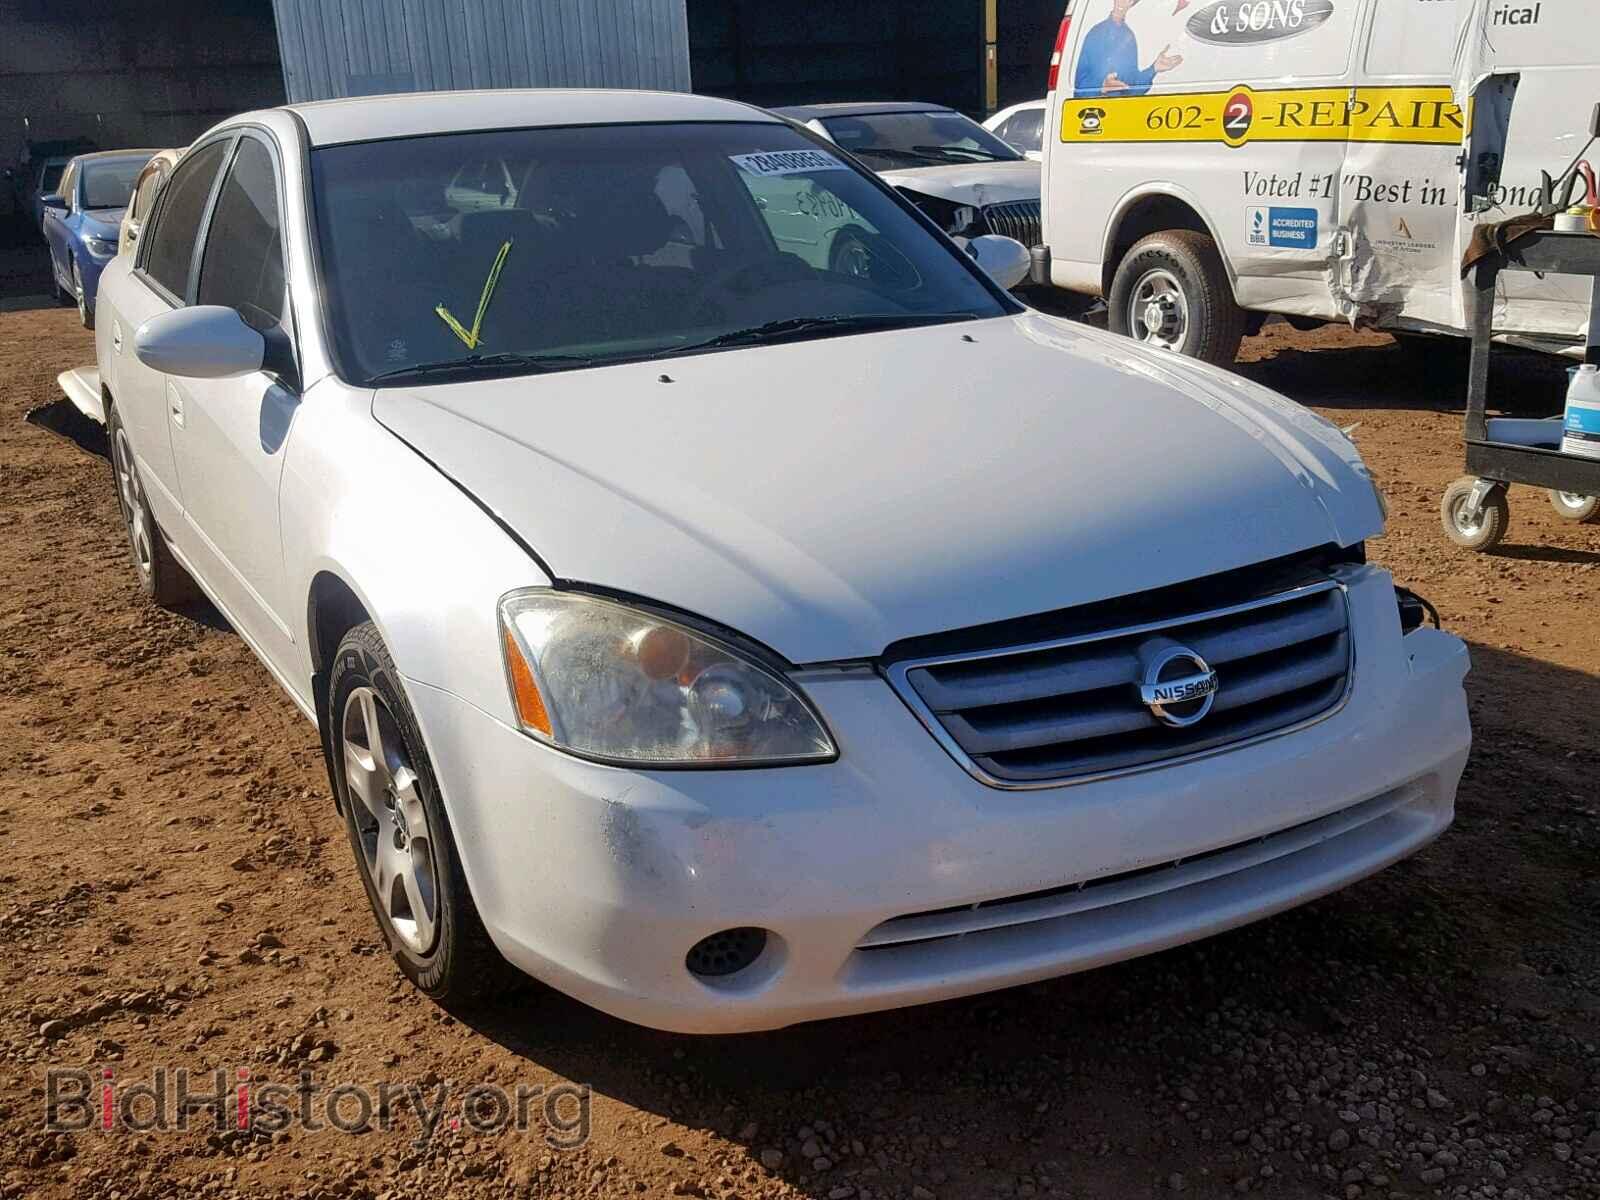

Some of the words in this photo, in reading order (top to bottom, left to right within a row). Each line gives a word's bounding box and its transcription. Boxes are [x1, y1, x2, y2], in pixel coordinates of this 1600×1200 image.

[1210, 5, 1229, 35] &
[1236, 0, 1305, 32] SONS
[1242, 171, 1302, 197] Voted
[1309, 173, 1334, 198] #1
[1420, 178, 1446, 206] in
[1153, 675, 1216, 700] NISSAN
